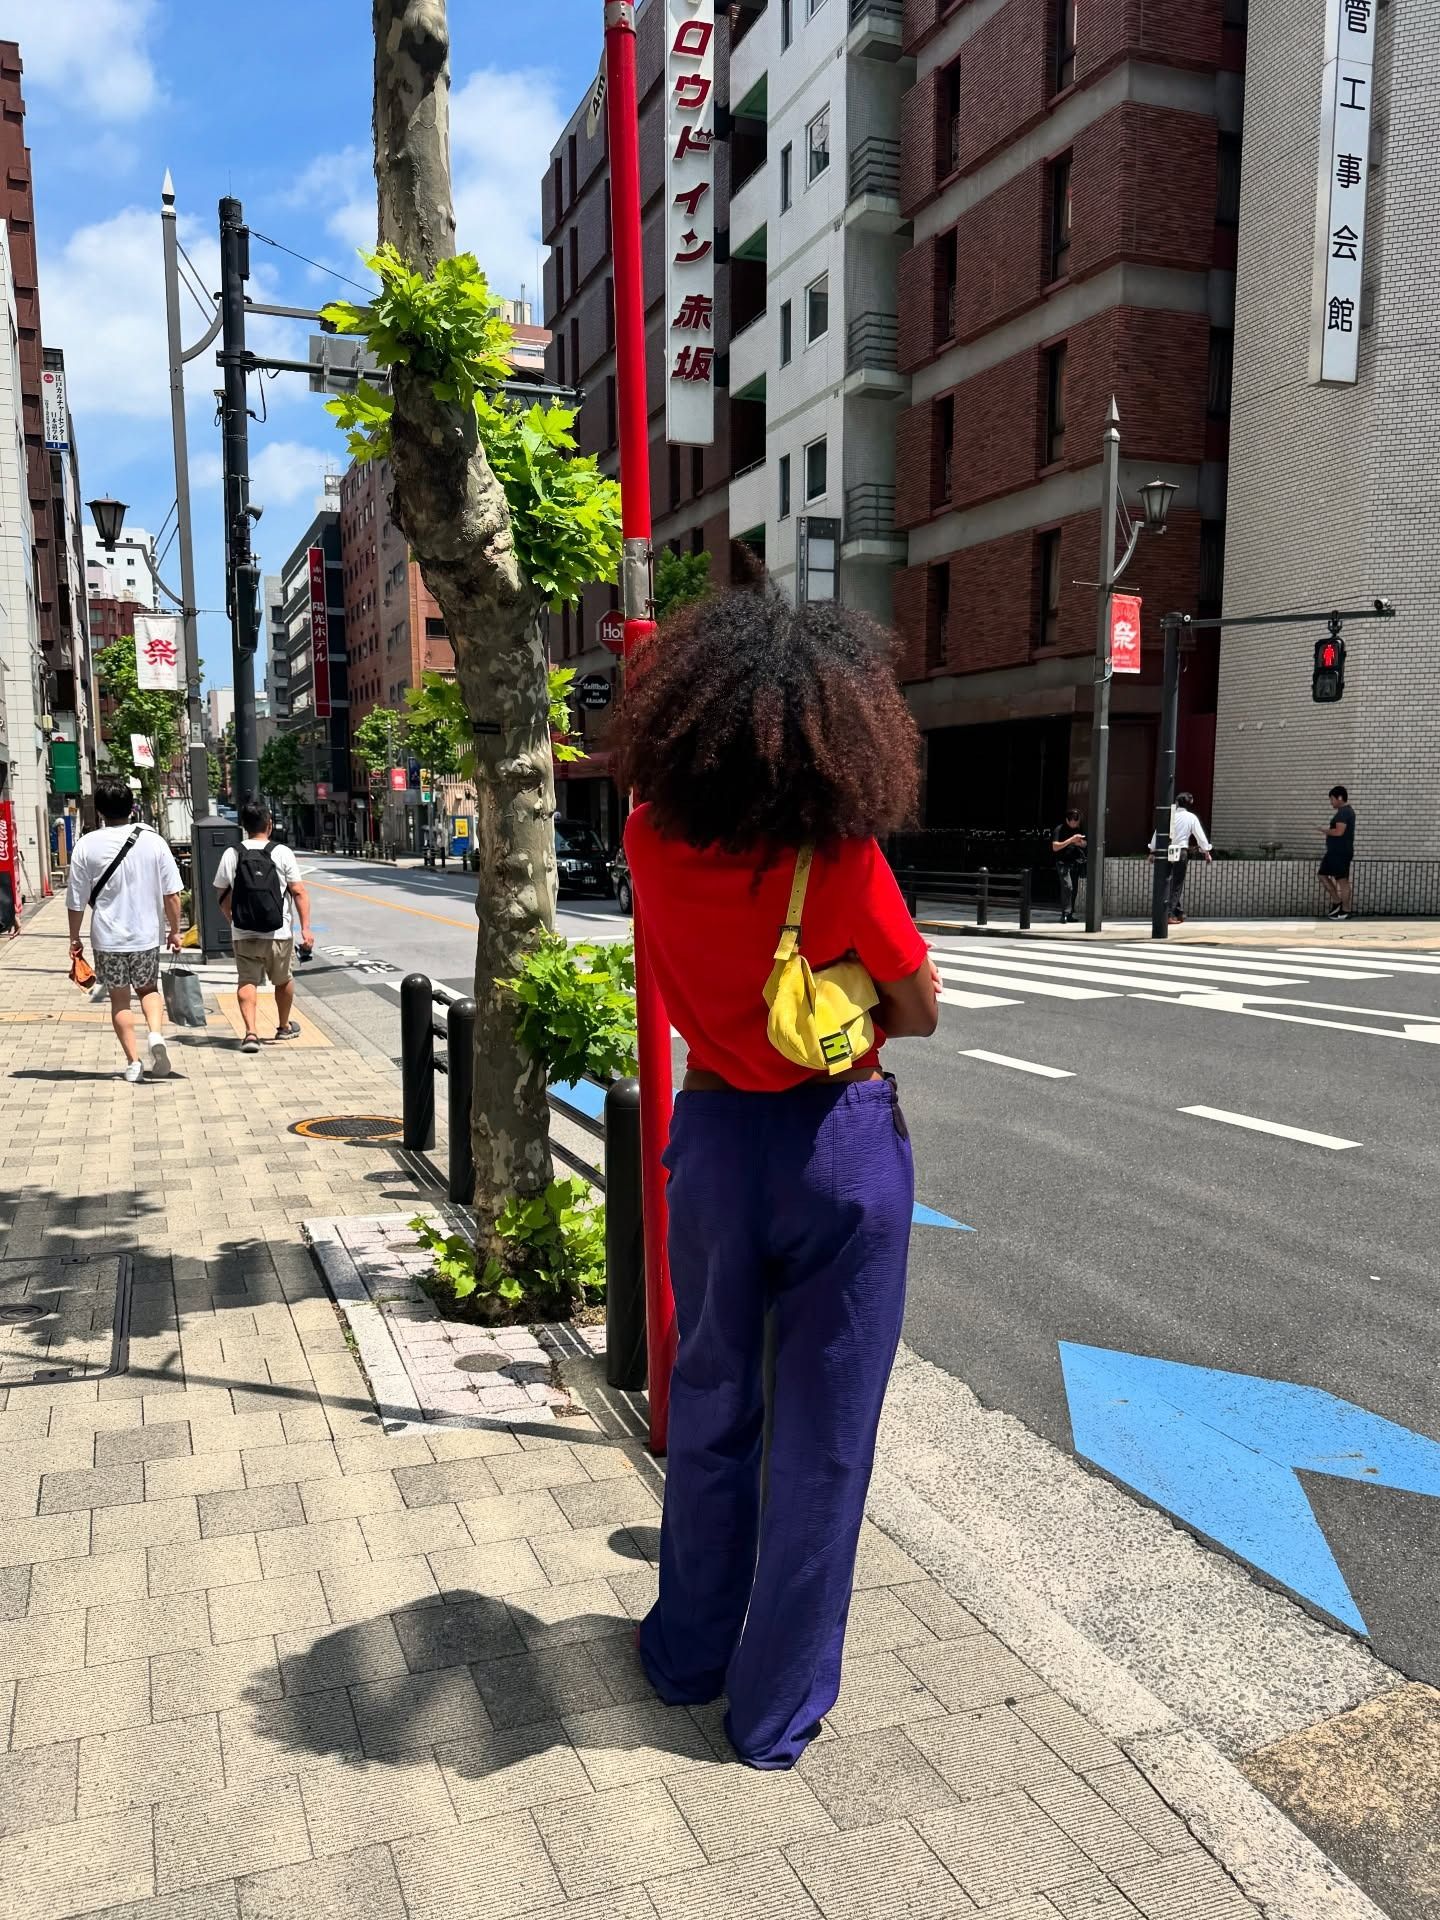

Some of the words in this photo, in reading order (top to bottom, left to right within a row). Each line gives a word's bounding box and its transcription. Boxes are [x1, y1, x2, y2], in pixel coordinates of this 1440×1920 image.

[1328, 0, 1371, 333] 管工事会館
[144, 639, 177, 666] 祭
[313, 602, 326, 662] 陽光ホテル
[1114, 621, 1137, 650] 祭
